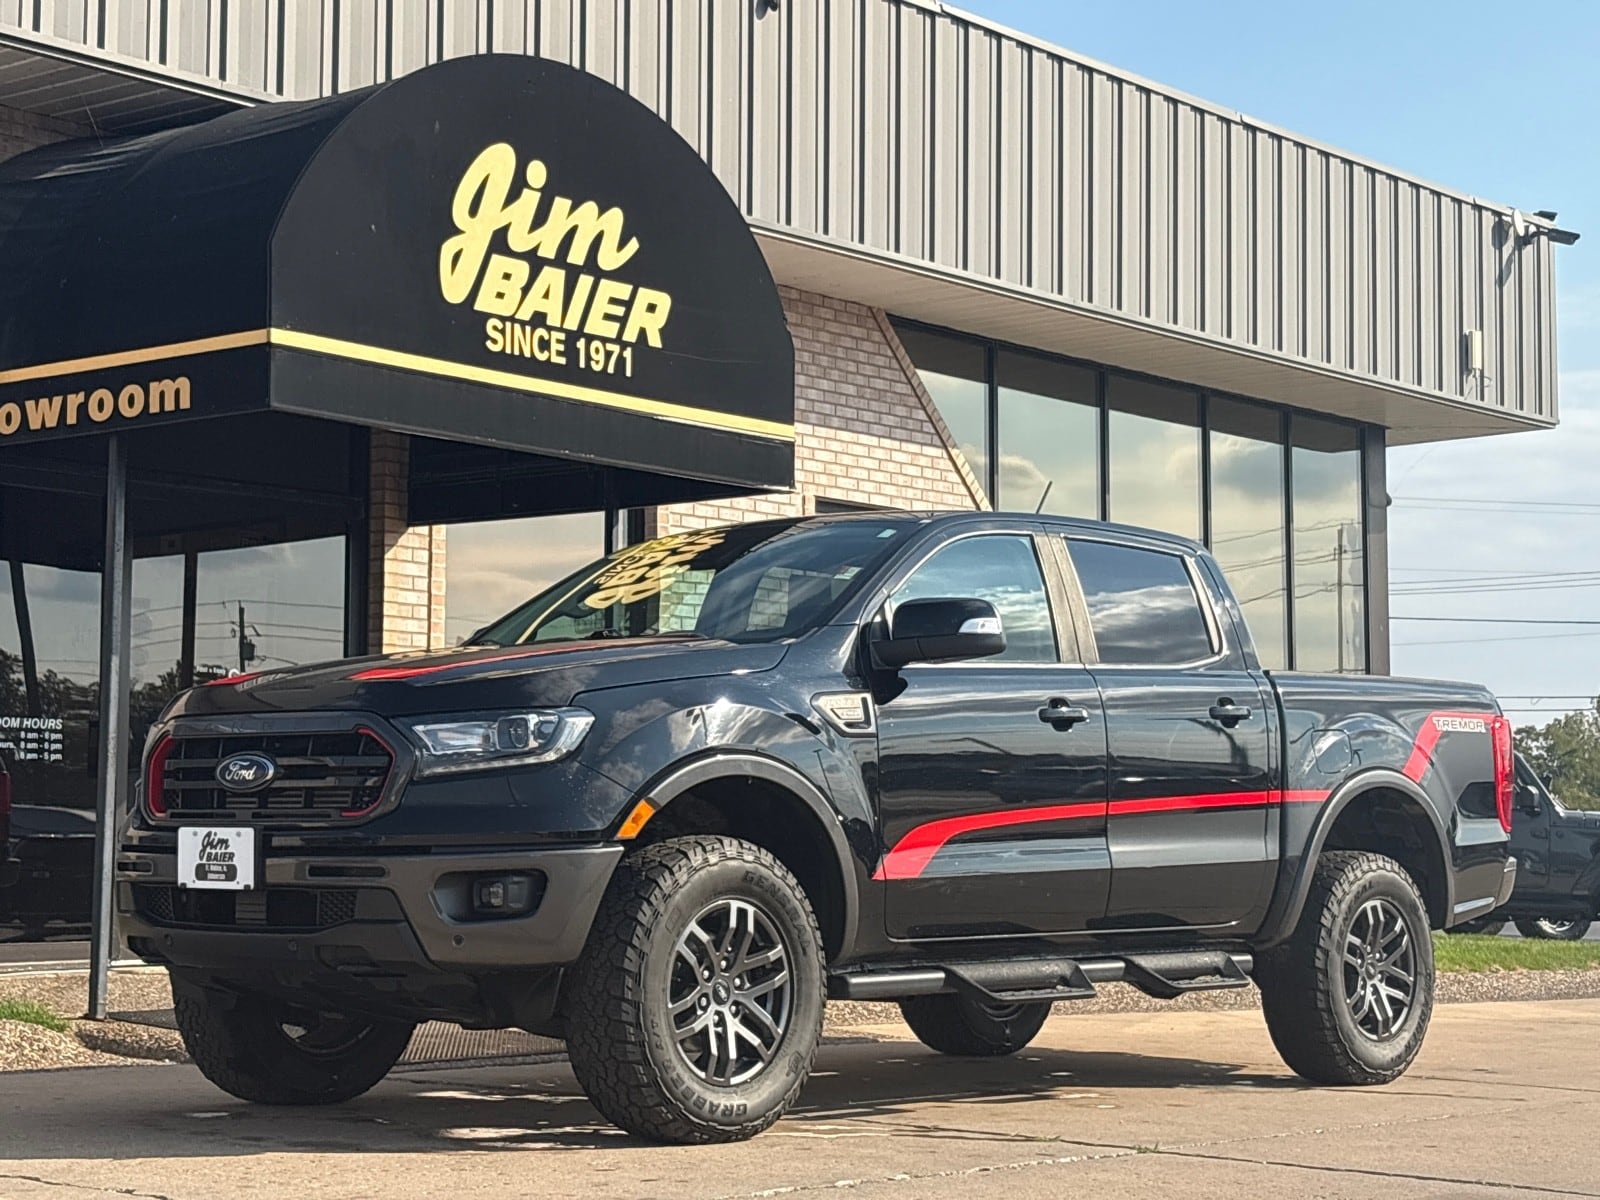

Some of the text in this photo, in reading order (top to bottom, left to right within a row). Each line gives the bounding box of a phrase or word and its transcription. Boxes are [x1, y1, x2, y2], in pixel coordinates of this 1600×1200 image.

[440, 142, 640, 304] Jim
[473, 253, 672, 349] BAIER
[485, 318, 633, 378] SINCE 1971
[0, 376, 191, 436] owroom
[0, 716, 63, 730] OM HOURS
[1434, 718, 1485, 731] TREMOR
[50, 733, 63, 741] pm
[225, 760, 257, 780] Ford
[199, 830, 231, 862] Jim
[205, 851, 236, 863] BAIER
